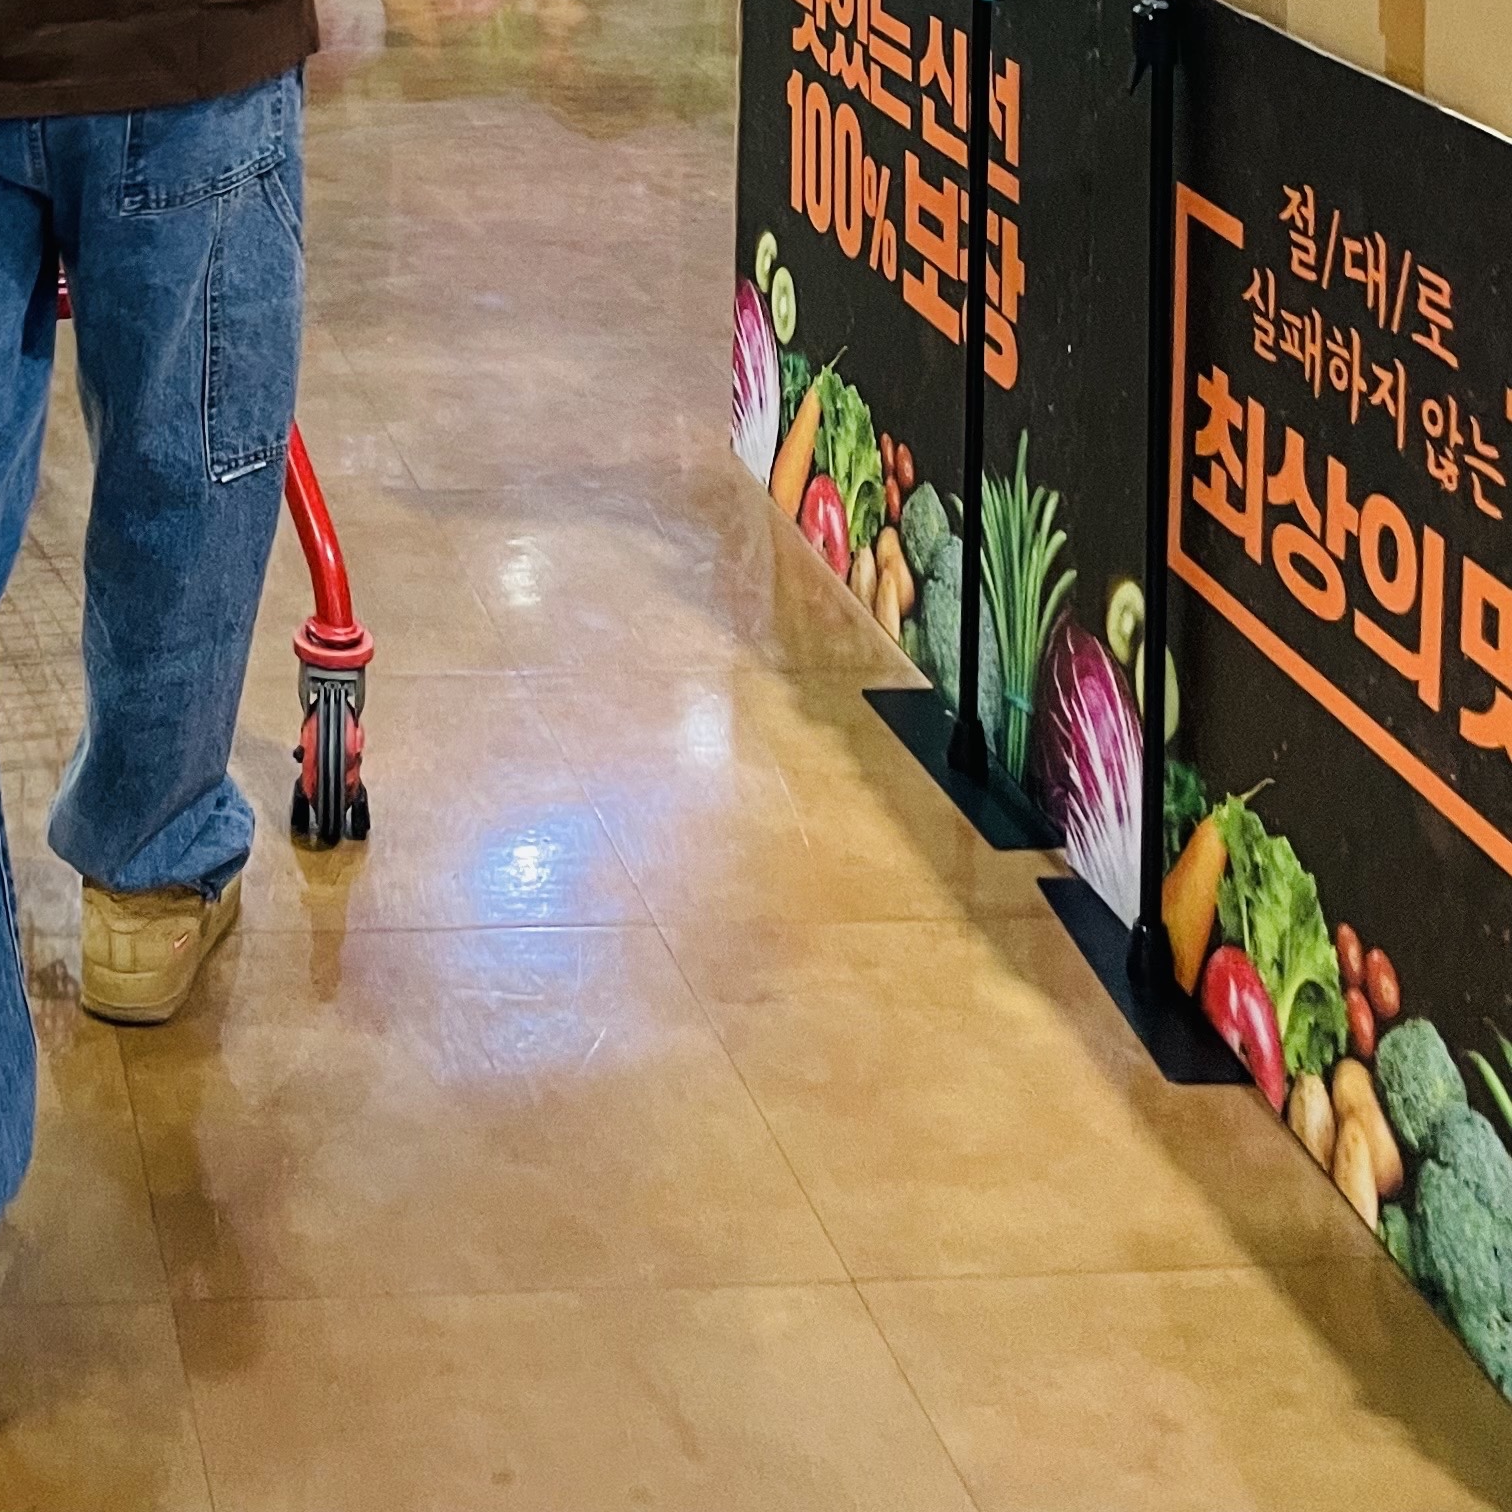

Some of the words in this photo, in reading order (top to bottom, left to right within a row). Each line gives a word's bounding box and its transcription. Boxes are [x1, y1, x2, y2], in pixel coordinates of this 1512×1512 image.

[786, 68, 898, 283] 100%
[919, 15, 1021, 206] 신선
[1278, 184, 1460, 370] 절/대/로
[1241, 267, 1408, 453] 실패하지
[1420, 393, 1508, 521] 않는
[1192, 364, 1445, 714] 최상의
